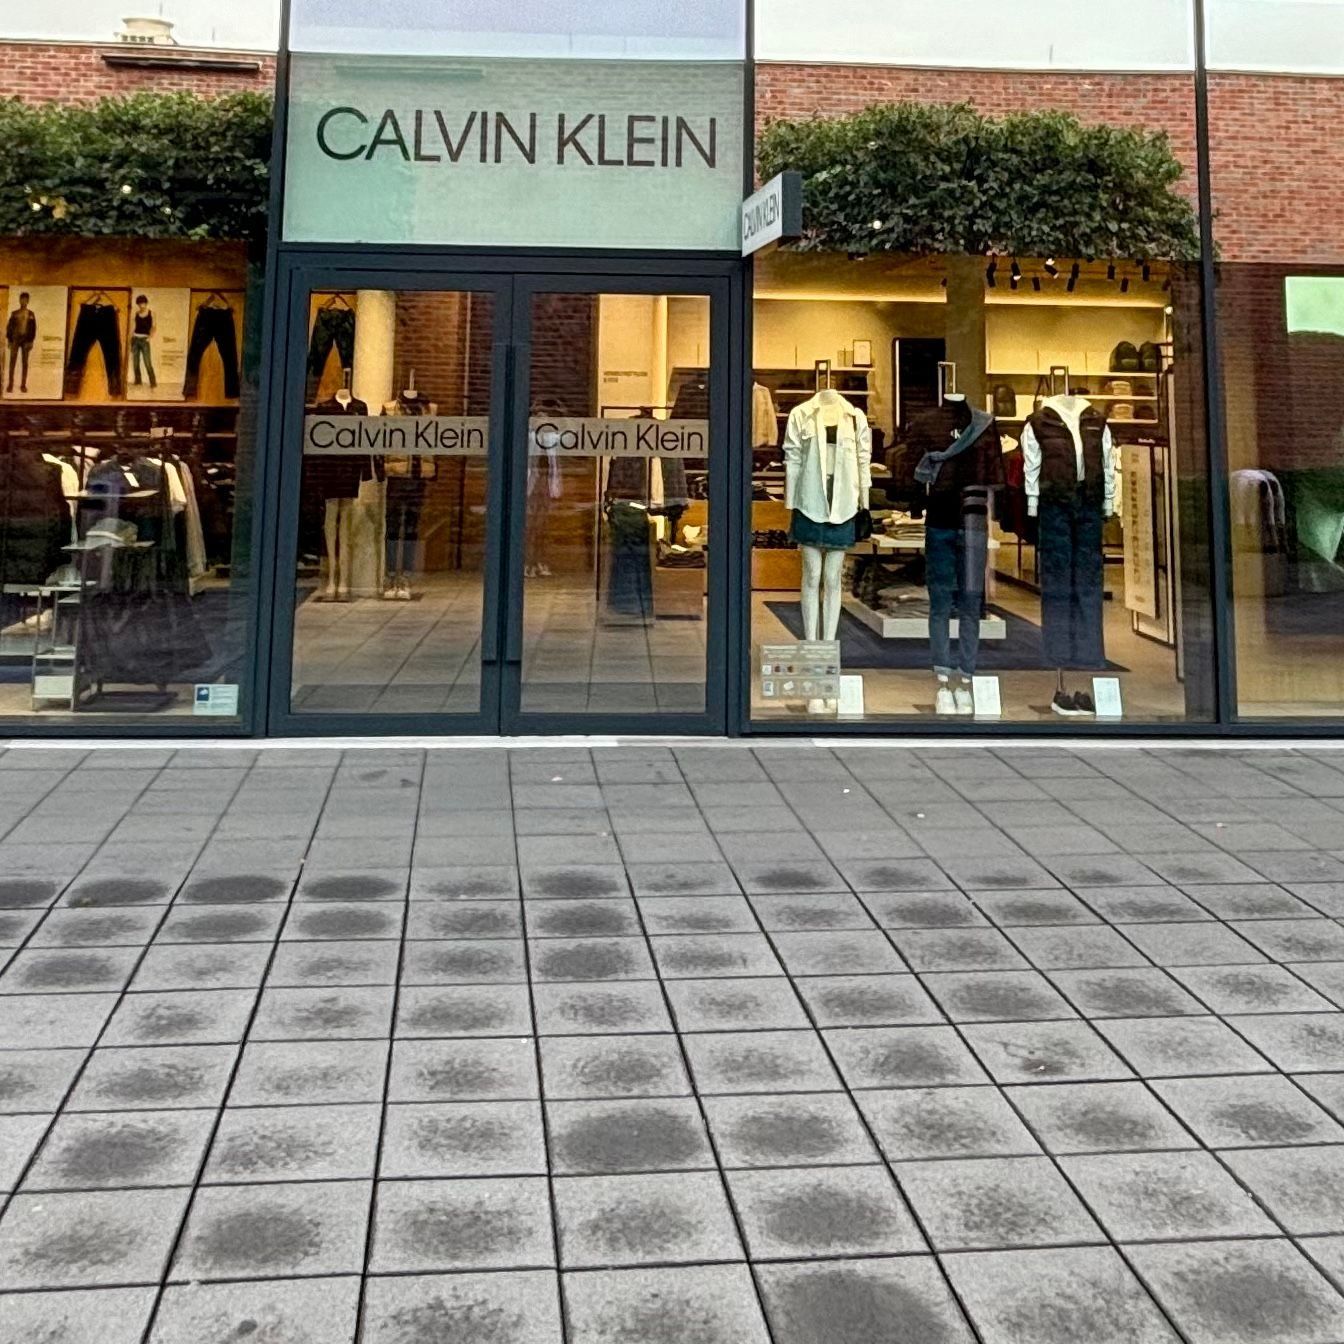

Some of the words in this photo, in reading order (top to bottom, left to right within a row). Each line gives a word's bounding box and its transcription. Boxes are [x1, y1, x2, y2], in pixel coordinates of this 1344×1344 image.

[316, 106, 536, 165] CALVIN
[557, 113, 716, 168] KLEIN
[310, 421, 406, 448] Calvin
[415, 420, 484, 449] Klein
[535, 423, 628, 450] Calvin
[636, 424, 704, 452] Klein
